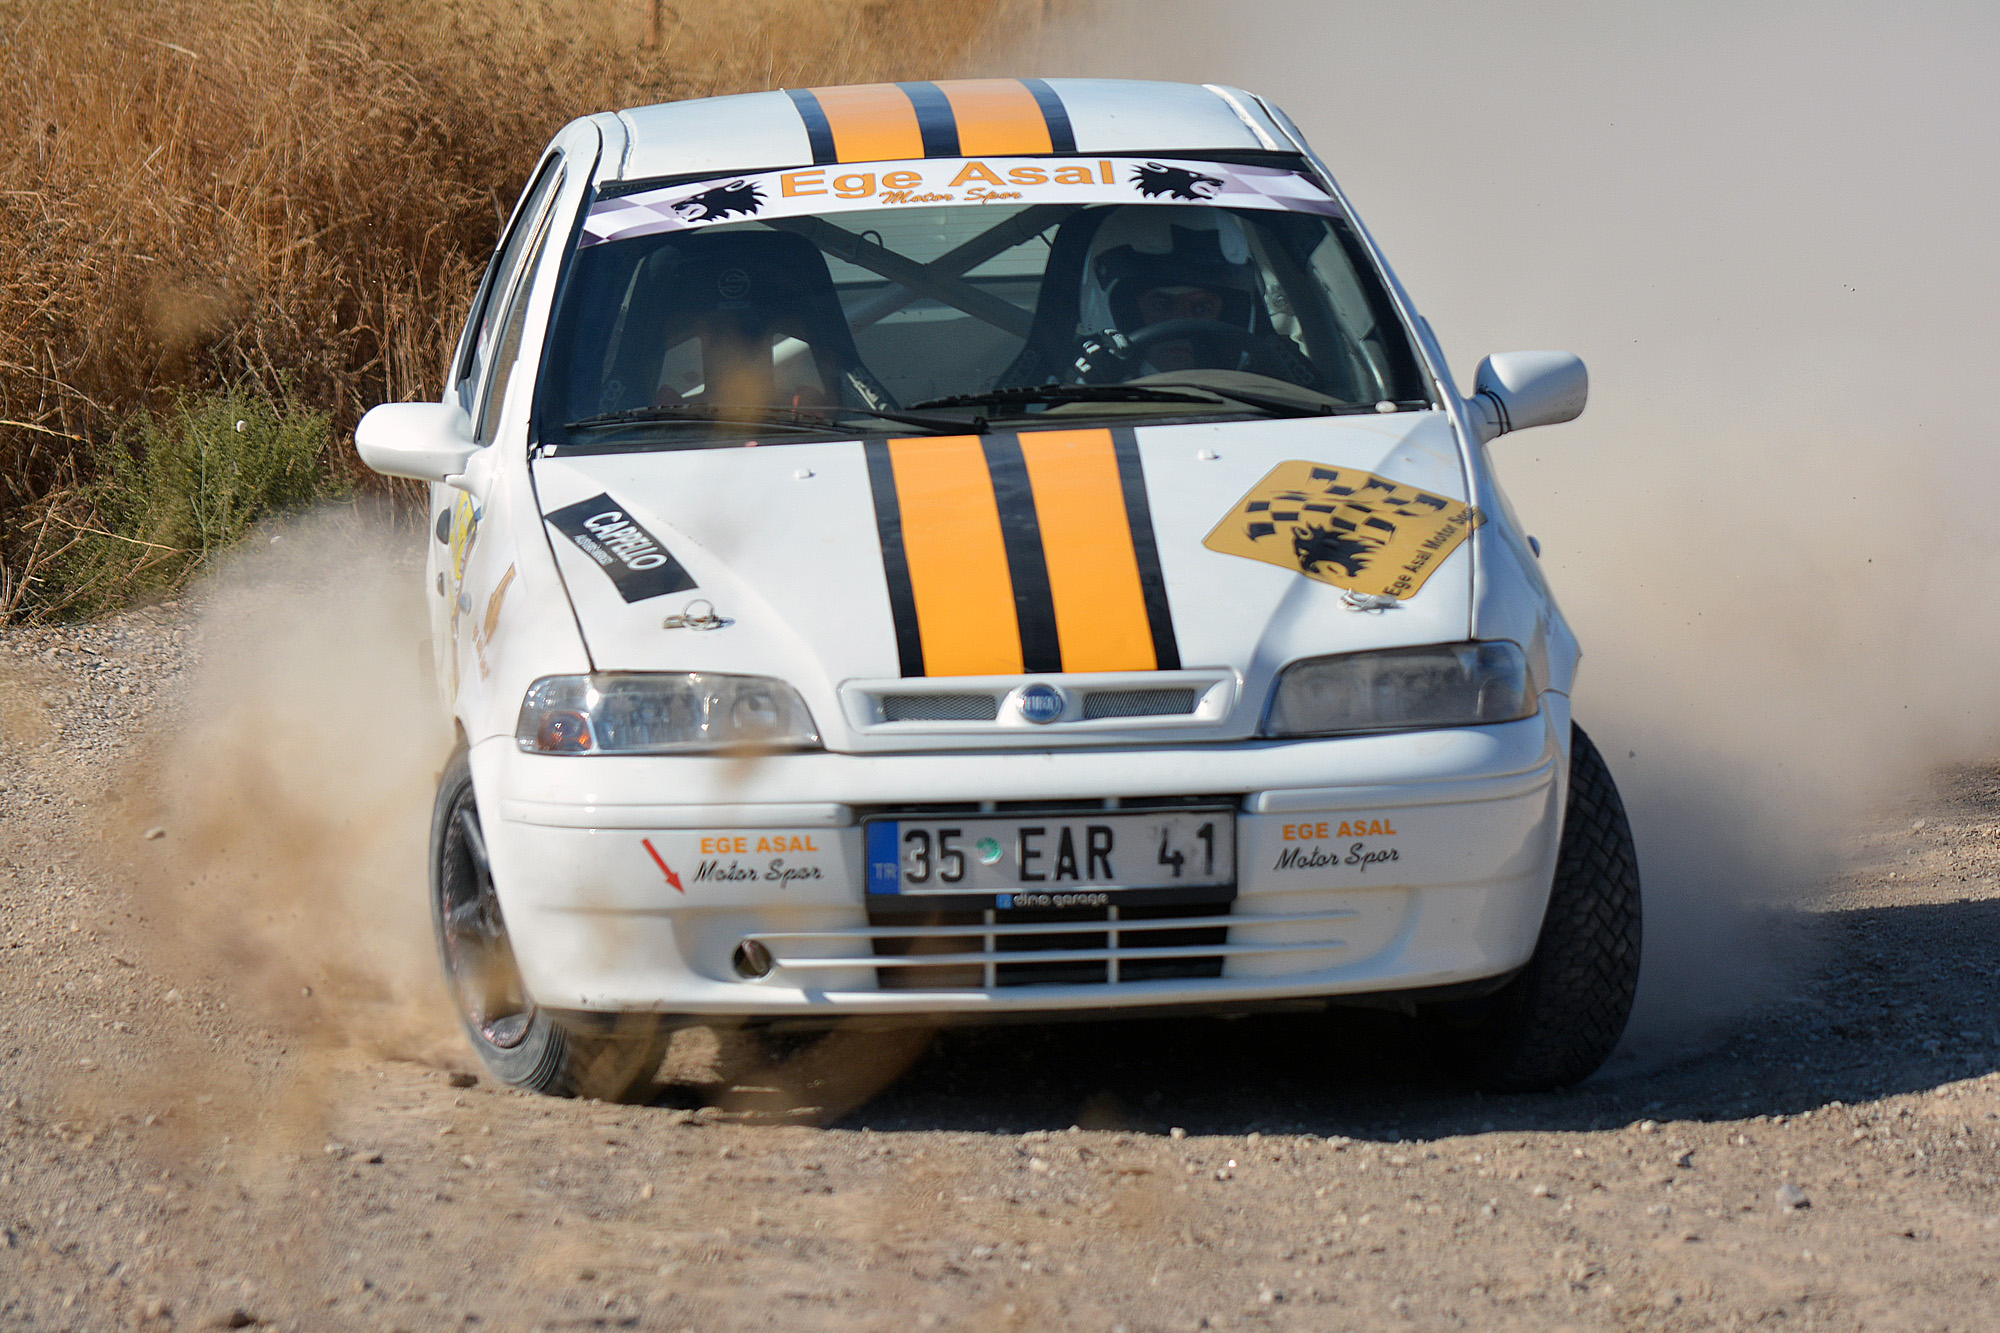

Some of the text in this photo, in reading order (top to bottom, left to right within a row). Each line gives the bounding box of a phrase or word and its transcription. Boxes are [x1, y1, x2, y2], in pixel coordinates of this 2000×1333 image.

[780, 160, 1116, 198] Ege Asal
[879, 187, 1024, 205] Motor Spor
[583, 511, 668, 570] CAPPELLO
[1382, 574, 1412, 597] Ege
[1402, 549, 1433, 573] Asal
[1421, 524, 1458, 550] Motor
[1283, 818, 1396, 840] EGE ASAL
[701, 835, 819, 854] EGE ASAL
[904, 821, 1216, 884] 35 EAR 41
[1273, 842, 1399, 872] Motor Spor
[693, 858, 824, 890] Motor Spor
[872, 862, 897, 880] TR
[1052, 892, 1109, 909] garage
